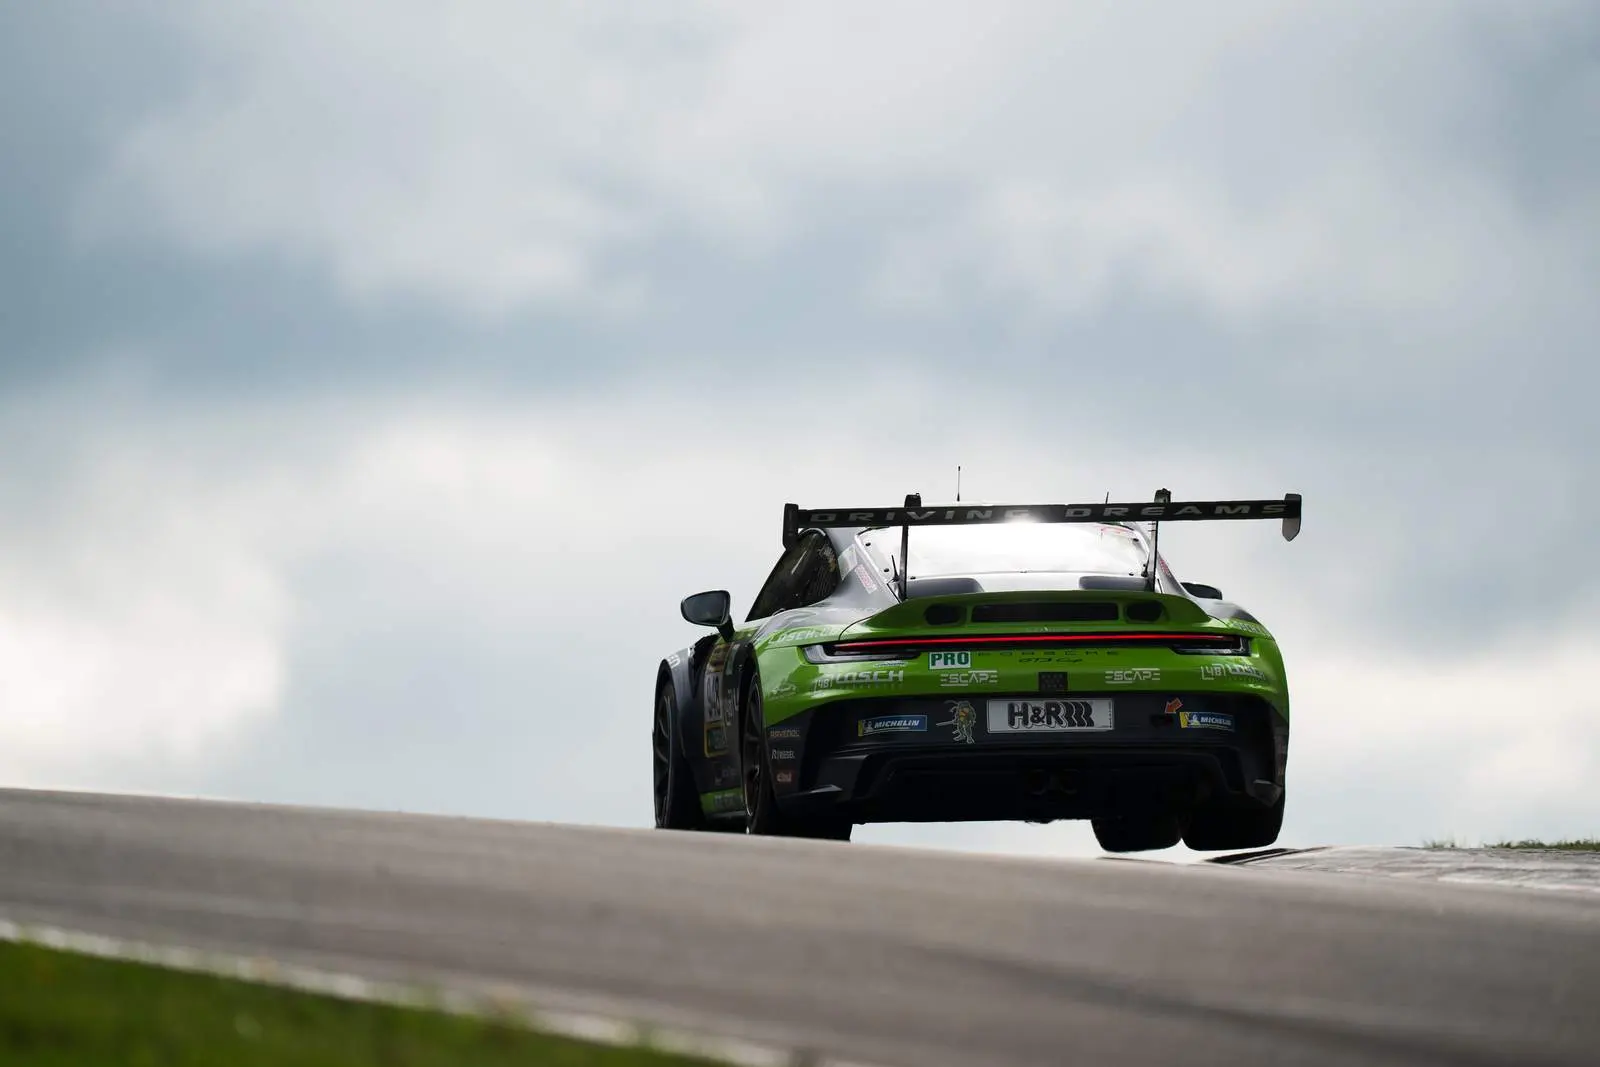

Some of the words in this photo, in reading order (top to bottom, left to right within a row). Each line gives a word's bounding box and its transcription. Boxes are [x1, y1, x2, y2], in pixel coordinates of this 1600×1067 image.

[1064, 504, 1287, 518] DREAMS
[931, 652, 970, 667] PRO
[939, 670, 998, 687] ESCAPE
[1105, 668, 1160, 684] ESCAPE
[874, 719, 920, 729] MICHELIN
[1199, 715, 1232, 727] MICHELIN
